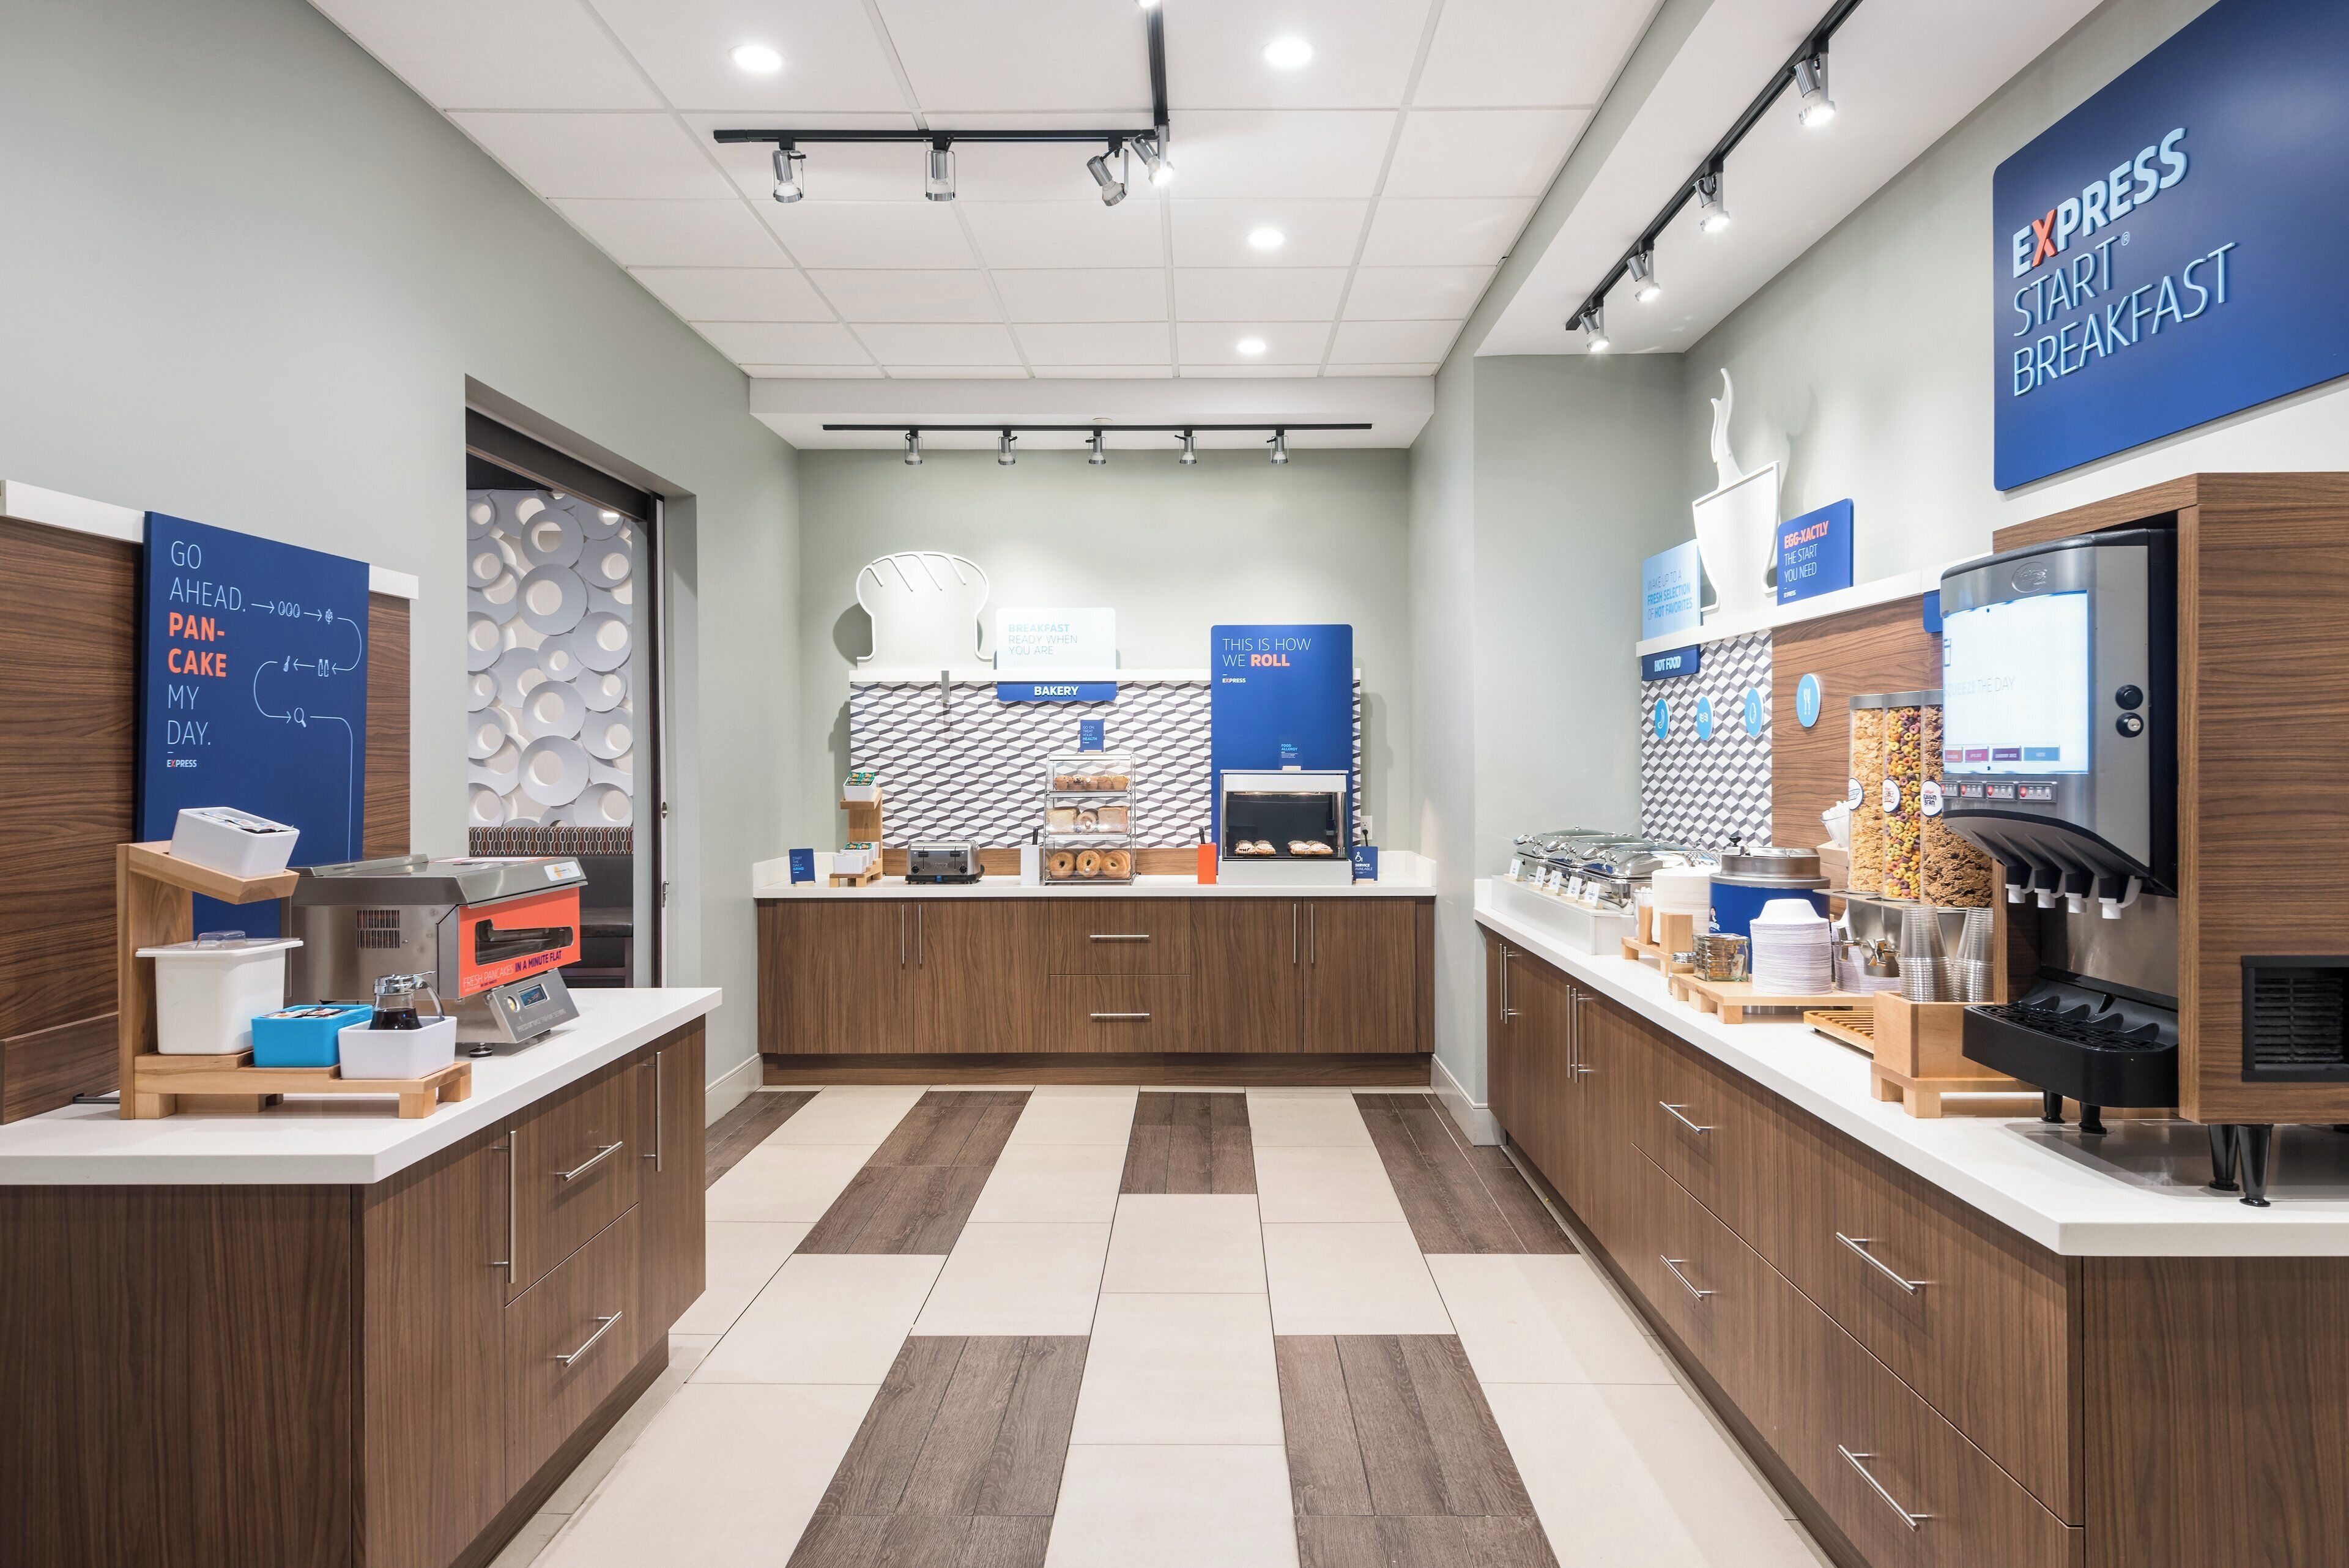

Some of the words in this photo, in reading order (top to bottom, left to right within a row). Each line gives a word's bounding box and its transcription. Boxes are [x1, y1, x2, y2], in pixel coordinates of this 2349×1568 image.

[2013, 128, 2187, 279] EXPRESS
[2014, 242, 2236, 397] BREAKFAST
[1784, 521, 1829, 549] EGG-XACTLY
[171, 541, 201, 570] GO
[1784, 551, 1797, 566] THE
[1798, 544, 1818, 562] START
[1647, 576, 1661, 591] WAKE
[1662, 574, 1669, 587] UP
[1670, 571, 1677, 583] TO
[1678, 570, 1682, 580] A
[1784, 567, 1798, 582] YOU
[1800, 562, 1817, 578] NEED
[169, 577, 246, 612] AHEAD.
[1647, 591, 1662, 606] FRESH
[1663, 582, 1691, 601] SELECTION
[1647, 608, 1654, 620] OF
[1655, 606, 1664, 619] HOT
[1666, 597, 1693, 616] FAVORITES
[169, 612, 225, 641] PAN-
[1009, 635, 1042, 644] READY
[1047, 635, 1077, 644] WHEN
[1009, 646, 1030, 655] YOU
[1034, 646, 1053, 655] ARE
[1222, 637, 1253, 651] THIS
[1258, 637, 1270, 651] IS
[1275, 637, 1312, 651] HOW
[168, 648, 227, 677] CAKE
[1222, 654, 1245, 667] WE
[1250, 654, 1290, 667] ROLL
[1654, 658, 1666, 672] HOT
[1666, 655, 1682, 671] FOOD
[1034, 685, 1079, 696] BAKERY
[1978, 678, 1992, 693] THE
[1995, 675, 2016, 692] DAY
[168, 684, 199, 710] MY
[167, 720, 211, 745] DAY.
[167, 759, 198, 768] EXPRESS
[463, 974, 483, 988] FRESH
[484, 964, 514, 982] PANCAKES
[515, 962, 522, 973] IN
[522, 960, 527, 971] A
[528, 954, 549, 968] MINUTE
[549, 950, 562, 962] FLAT
